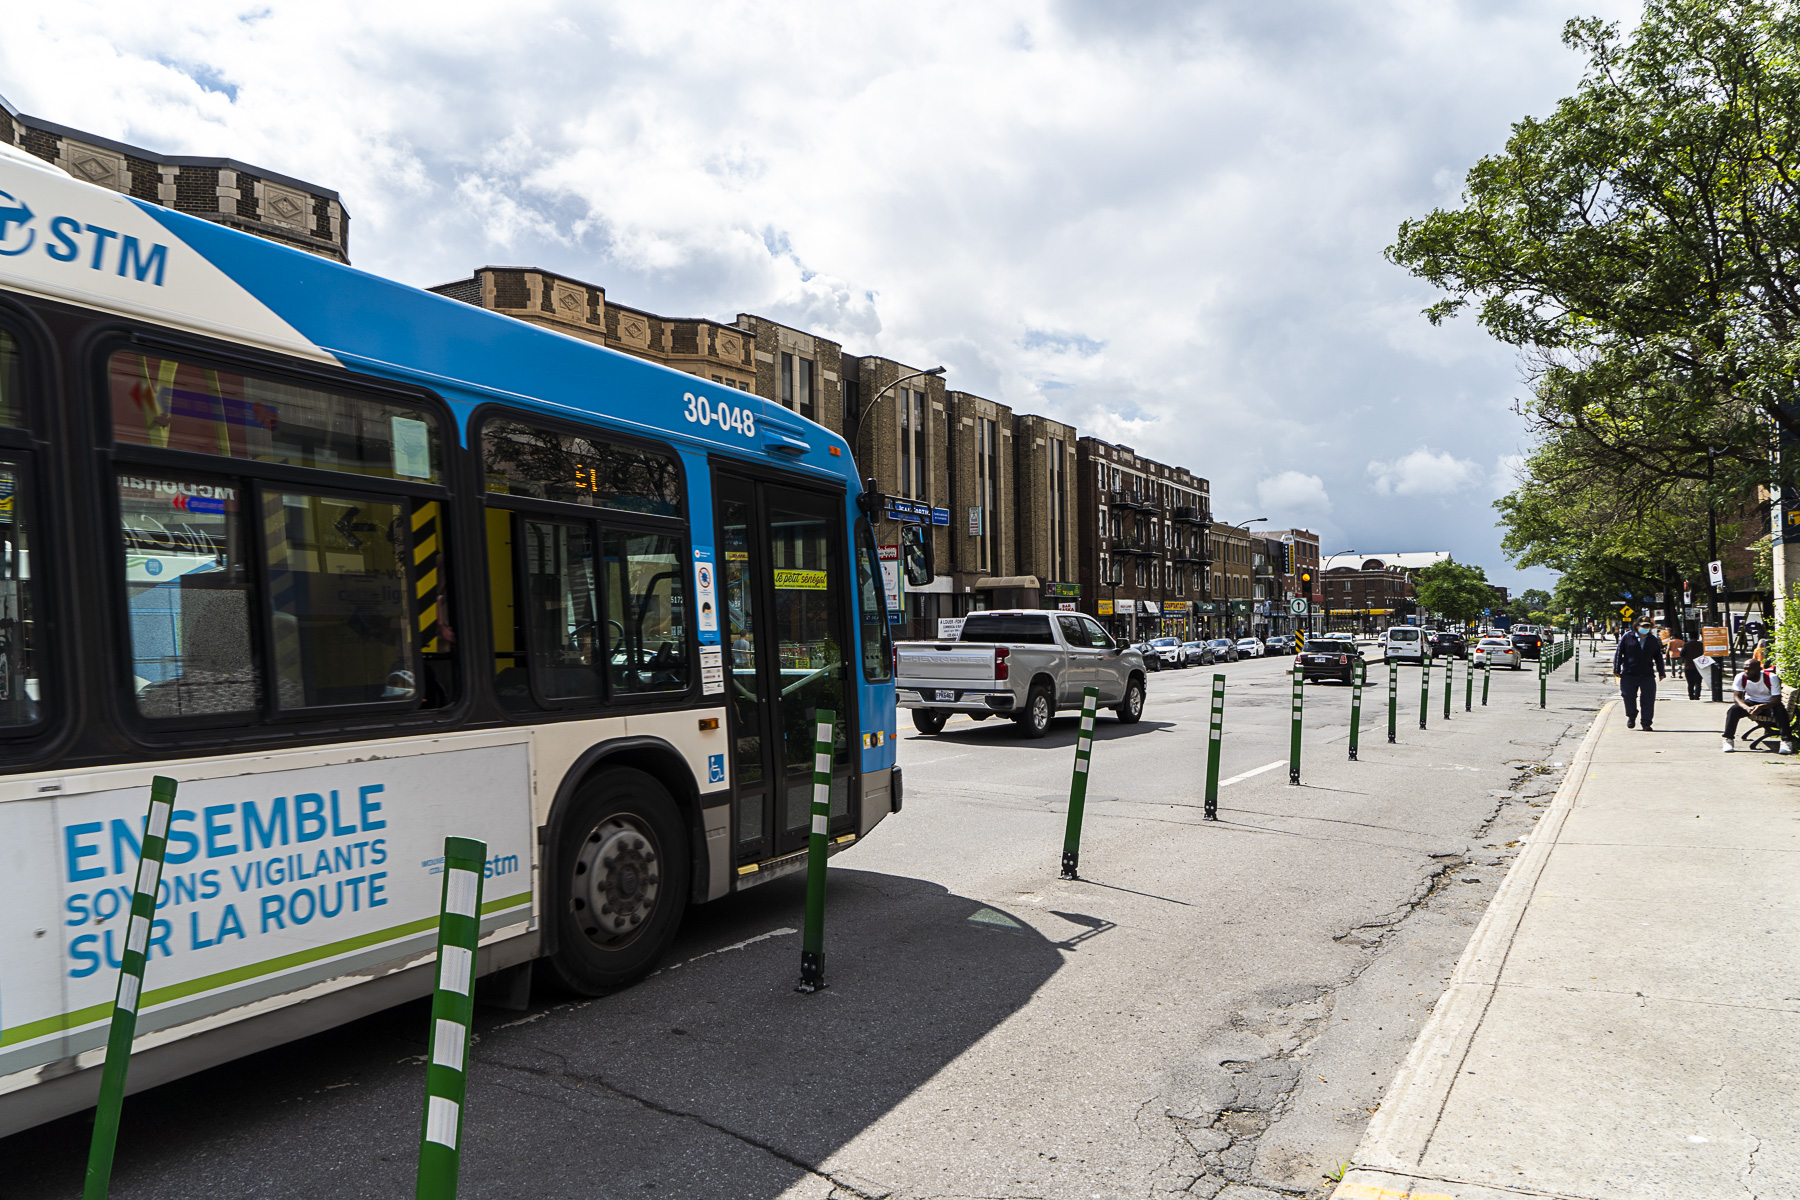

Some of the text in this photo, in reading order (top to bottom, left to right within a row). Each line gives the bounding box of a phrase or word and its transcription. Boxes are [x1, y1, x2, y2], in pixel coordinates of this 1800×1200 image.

[45, 216, 168, 287] STM
[683, 392, 756, 438] 30-048
[63, 784, 387, 883] ENSEMBLE
[231, 838, 388, 893] VIGILANTS
[484, 854, 519, 879] stm
[68, 871, 388, 979] SUR LA ROUTE
